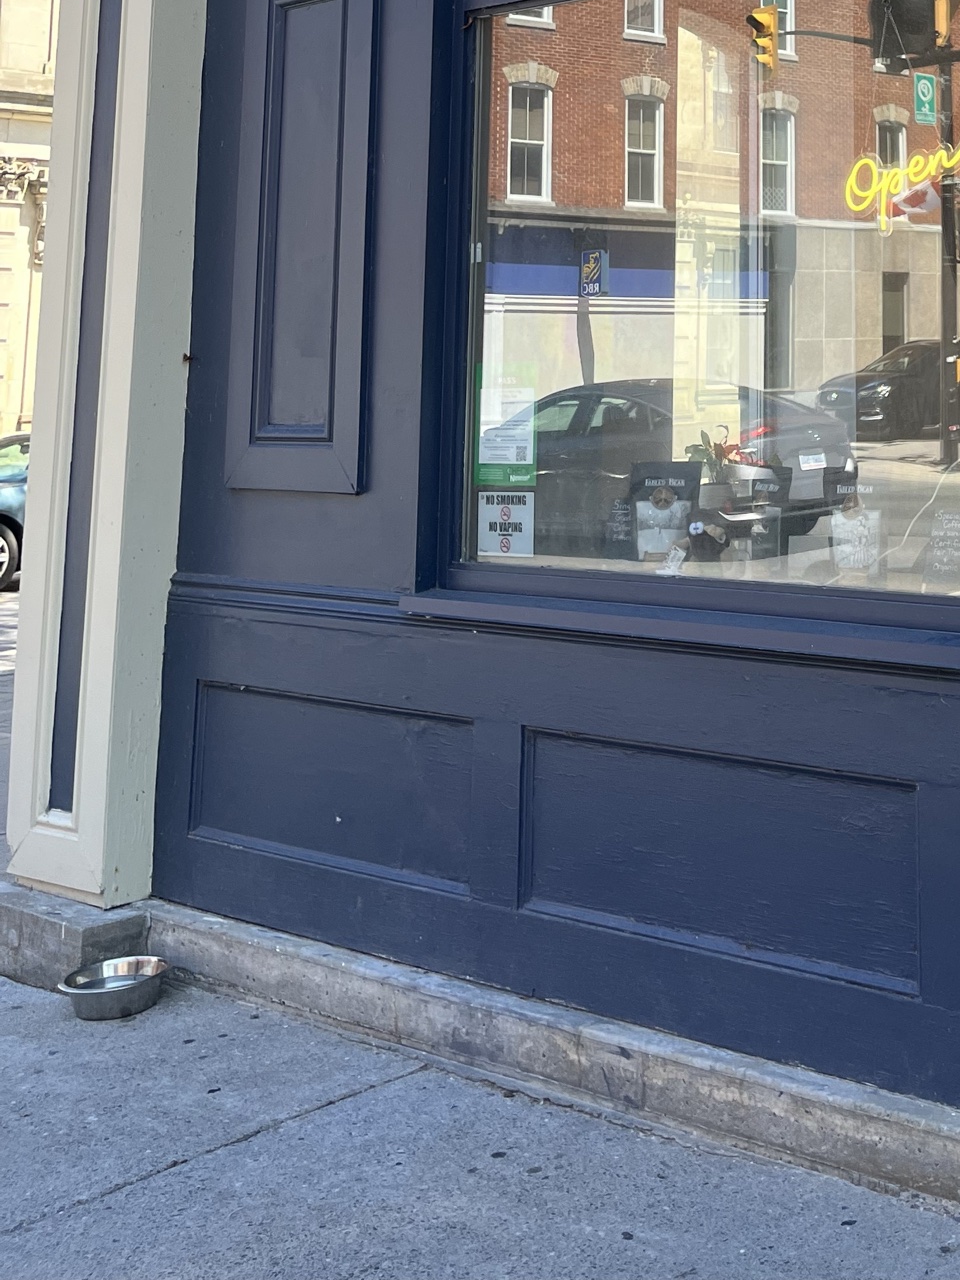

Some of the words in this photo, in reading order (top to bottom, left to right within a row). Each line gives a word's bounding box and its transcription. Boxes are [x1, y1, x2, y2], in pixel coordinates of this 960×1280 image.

[668, 478, 686, 487] BEAN
[485, 494, 495, 506] NO
[496, 494, 527, 506] SMOKING
[488, 521, 498, 533] NO
[499, 521, 523, 533] VAPING
[933, 548, 946, 556] Fair
[932, 562, 959, 575] Organic
